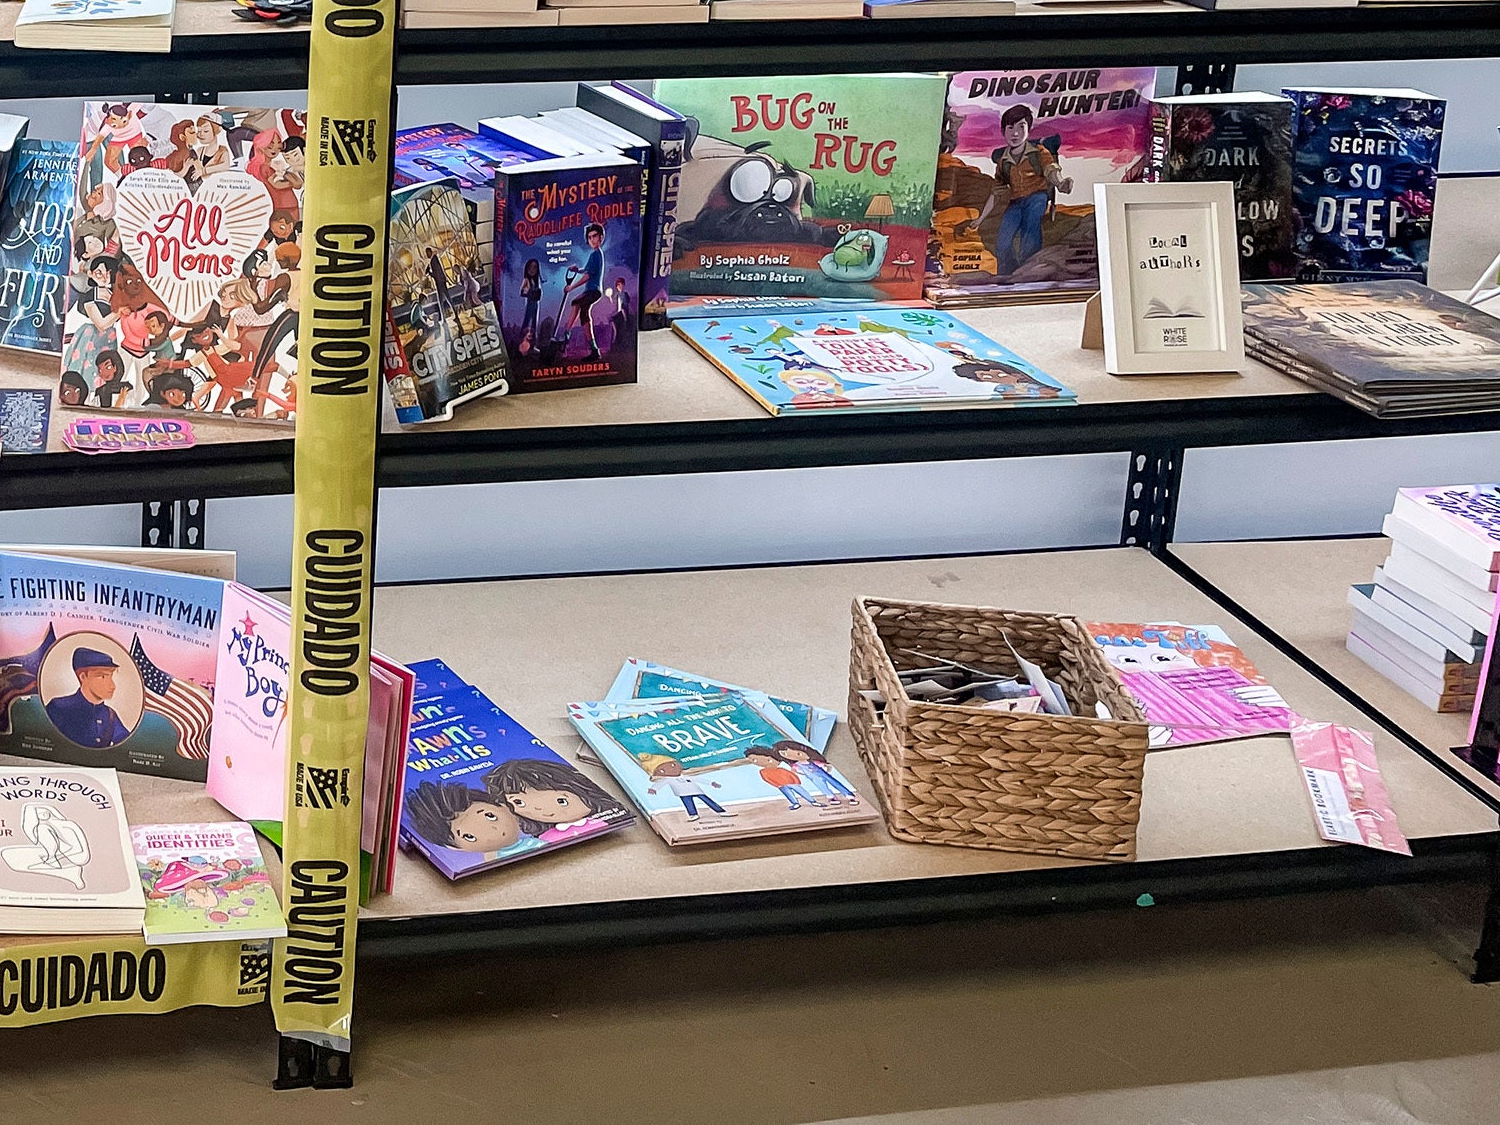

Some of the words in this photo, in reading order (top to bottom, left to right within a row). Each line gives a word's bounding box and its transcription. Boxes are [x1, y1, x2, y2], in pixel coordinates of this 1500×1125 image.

[968, 72, 1101, 99] DINOSAUR
[730, 93, 816, 134] BUG
[810, 133, 897, 176] RUG
[1330, 137, 1407, 156] SECRETS
[1348, 164, 1381, 189] SO
[154, 198, 228, 246] All
[587, 201, 634, 224] RIDDLE
[1314, 197, 1408, 238] DEEP
[137, 230, 236, 281] Moms
[310, 223, 376, 396] CAUTION
[10, 578, 86, 602] FIGHTING
[94, 585, 218, 631] INFANTRYMAN
[300, 530, 365, 696] CUIDADO
[655, 714, 752, 755] BRAVE
[0, 786, 68, 803] WORDS
[39, 774, 111, 811] THROUGH
[284, 860, 349, 1005] CAUTION
